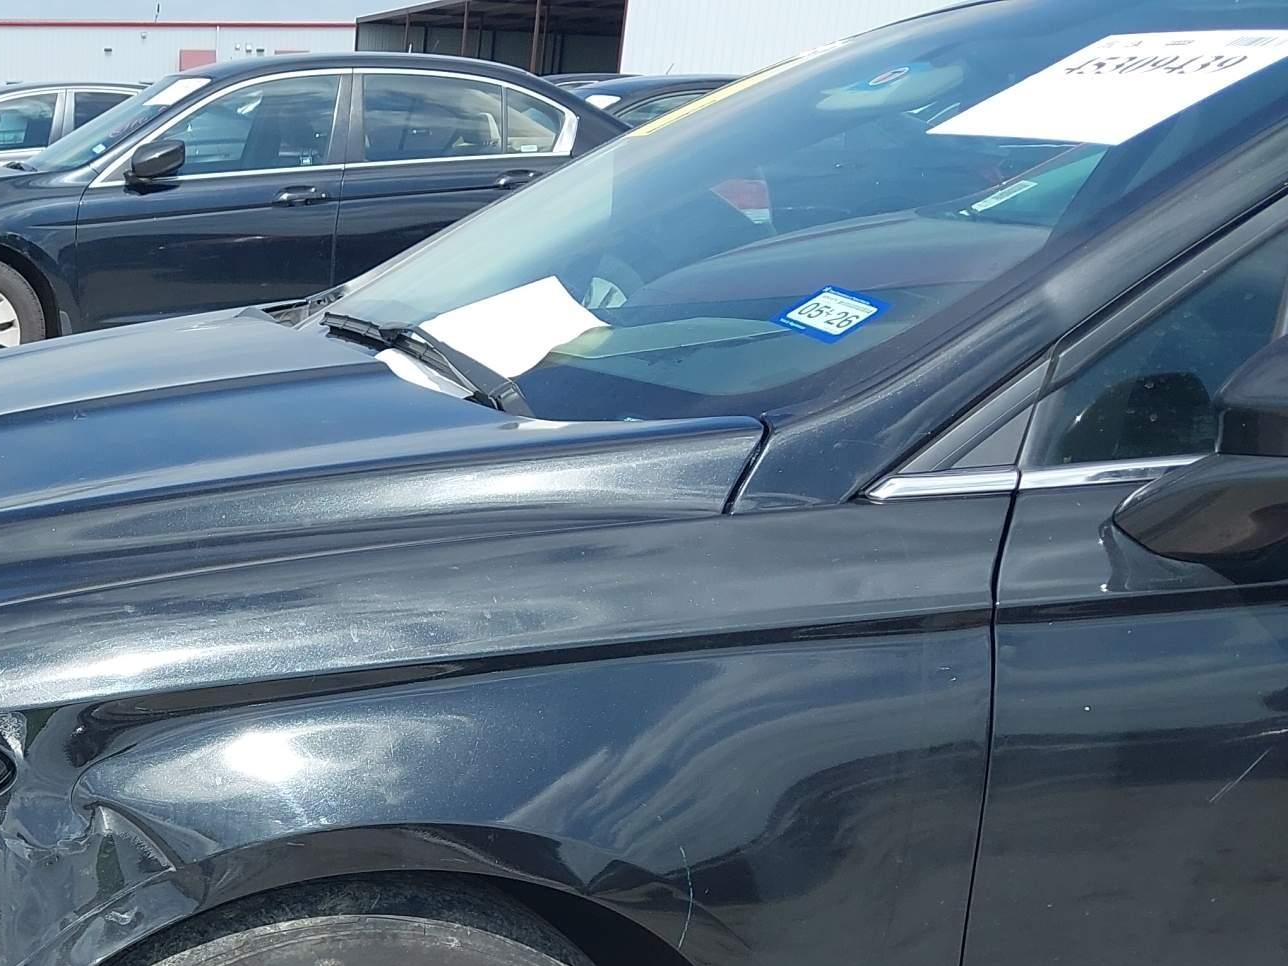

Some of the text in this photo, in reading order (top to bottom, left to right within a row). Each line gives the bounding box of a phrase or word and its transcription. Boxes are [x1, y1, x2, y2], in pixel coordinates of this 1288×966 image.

[1064, 54, 1249, 75] 45309439
[797, 301, 831, 319] 05
[823, 311, 860, 329] 26
